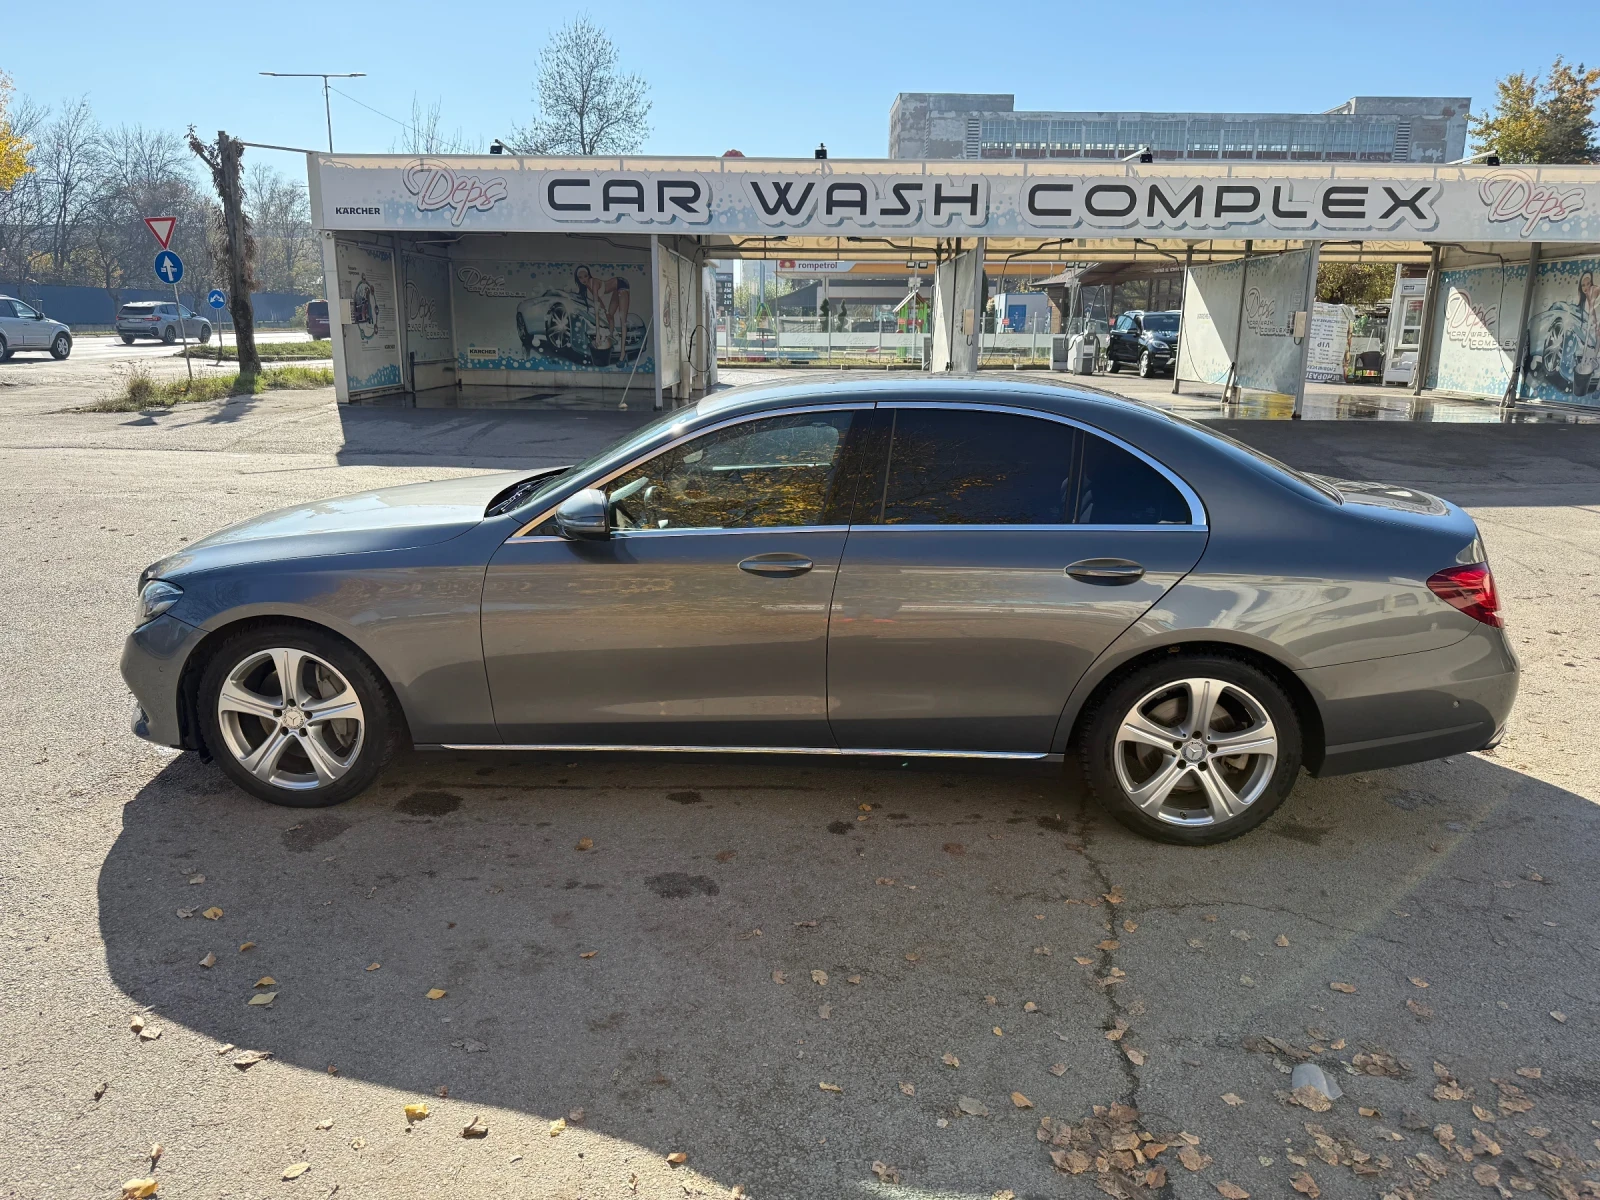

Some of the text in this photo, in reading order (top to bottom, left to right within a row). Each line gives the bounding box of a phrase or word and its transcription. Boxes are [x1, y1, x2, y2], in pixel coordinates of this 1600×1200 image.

[404, 159, 507, 226] Deps
[547, 178, 1431, 220] CAR WASH COMPLEX
[1479, 169, 1585, 237] Deps
[798, 261, 838, 271] rompetrol
[1471, 339, 1517, 347] COMPLEX
